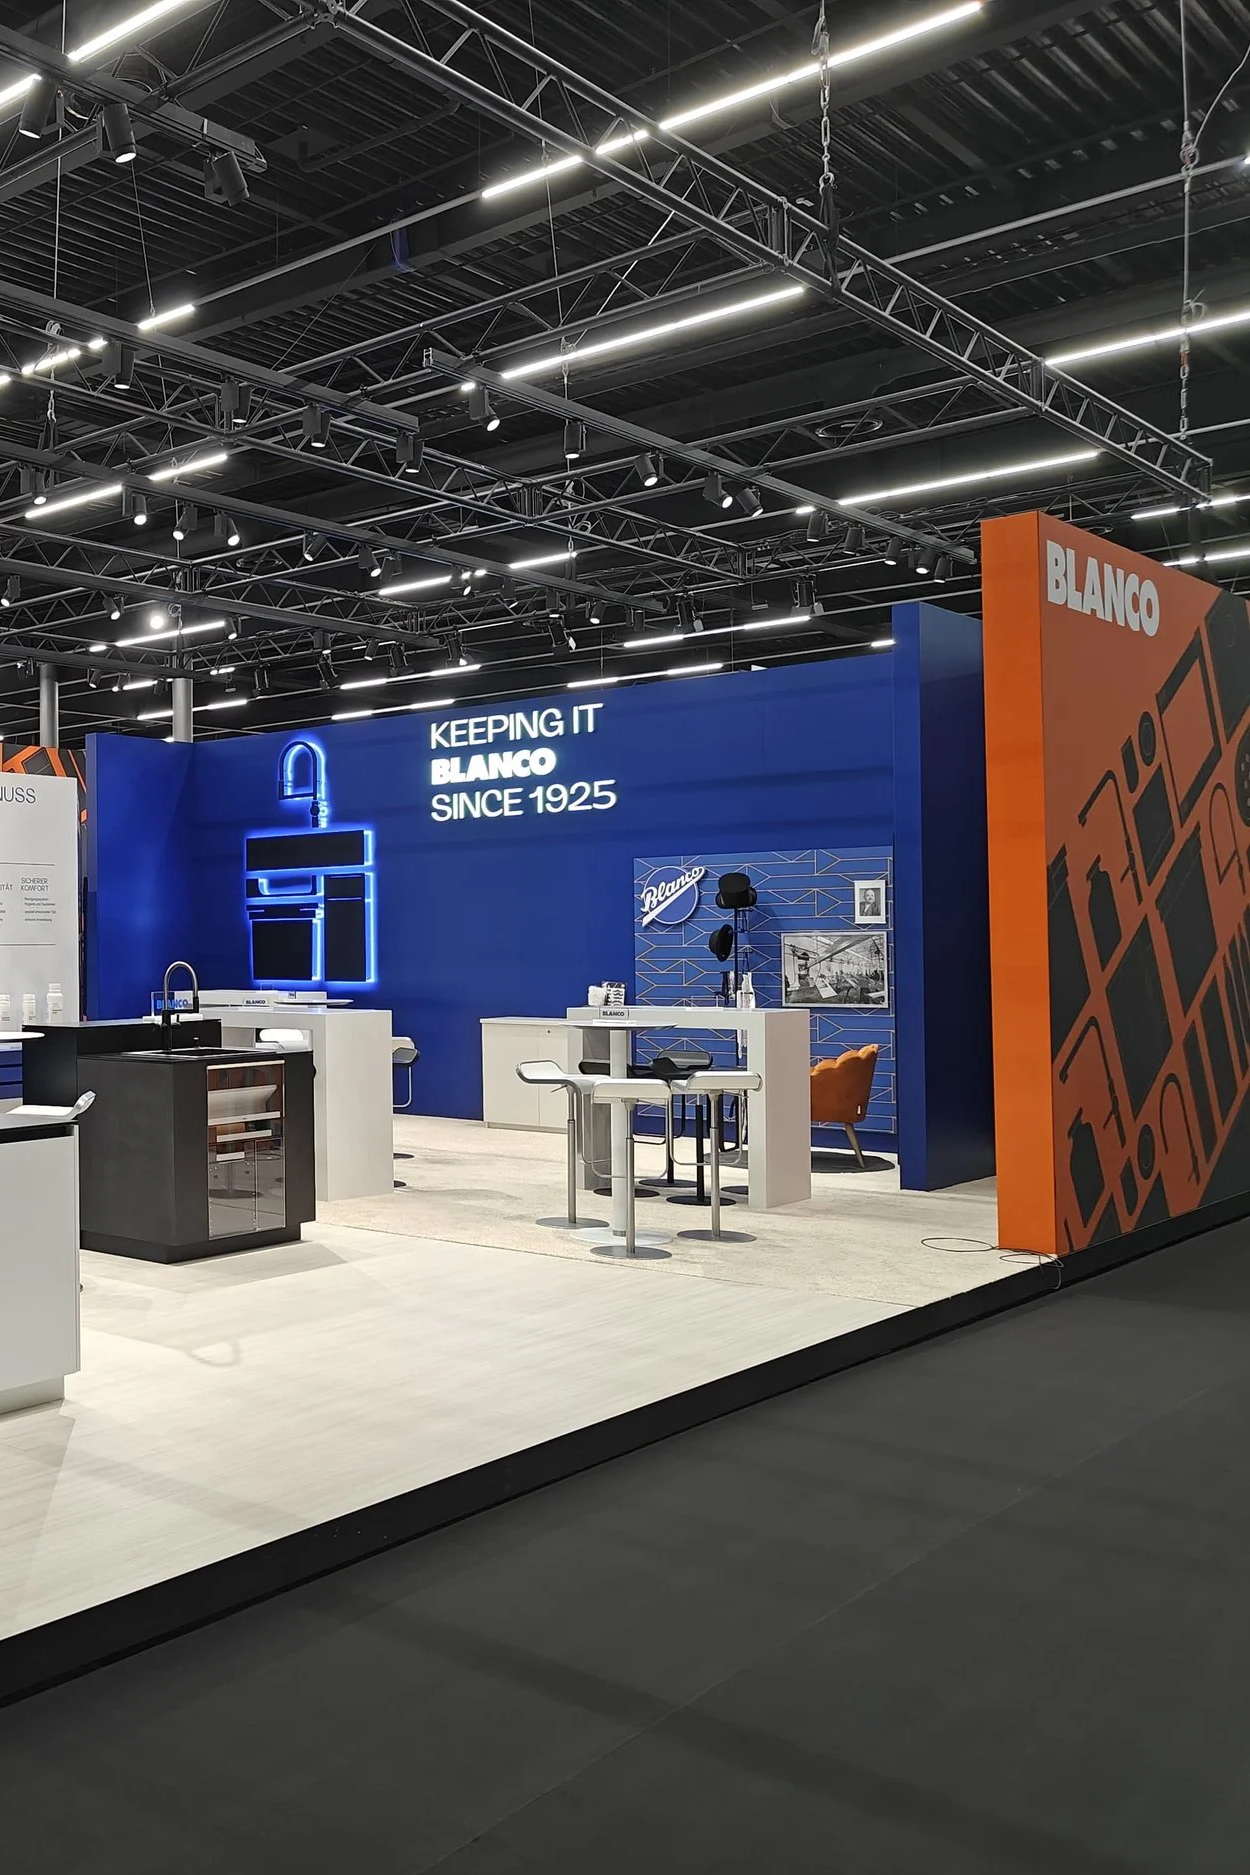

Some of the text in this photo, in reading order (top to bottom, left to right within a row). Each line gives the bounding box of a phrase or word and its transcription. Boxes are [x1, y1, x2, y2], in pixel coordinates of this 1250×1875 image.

[1047, 540, 1160, 637] BLANCO
[430, 703, 604, 750] KEEPING IT
[431, 747, 557, 786] BLANCO
[430, 779, 617, 823] SINCE 1925
[640, 867, 705, 914] Blanco
